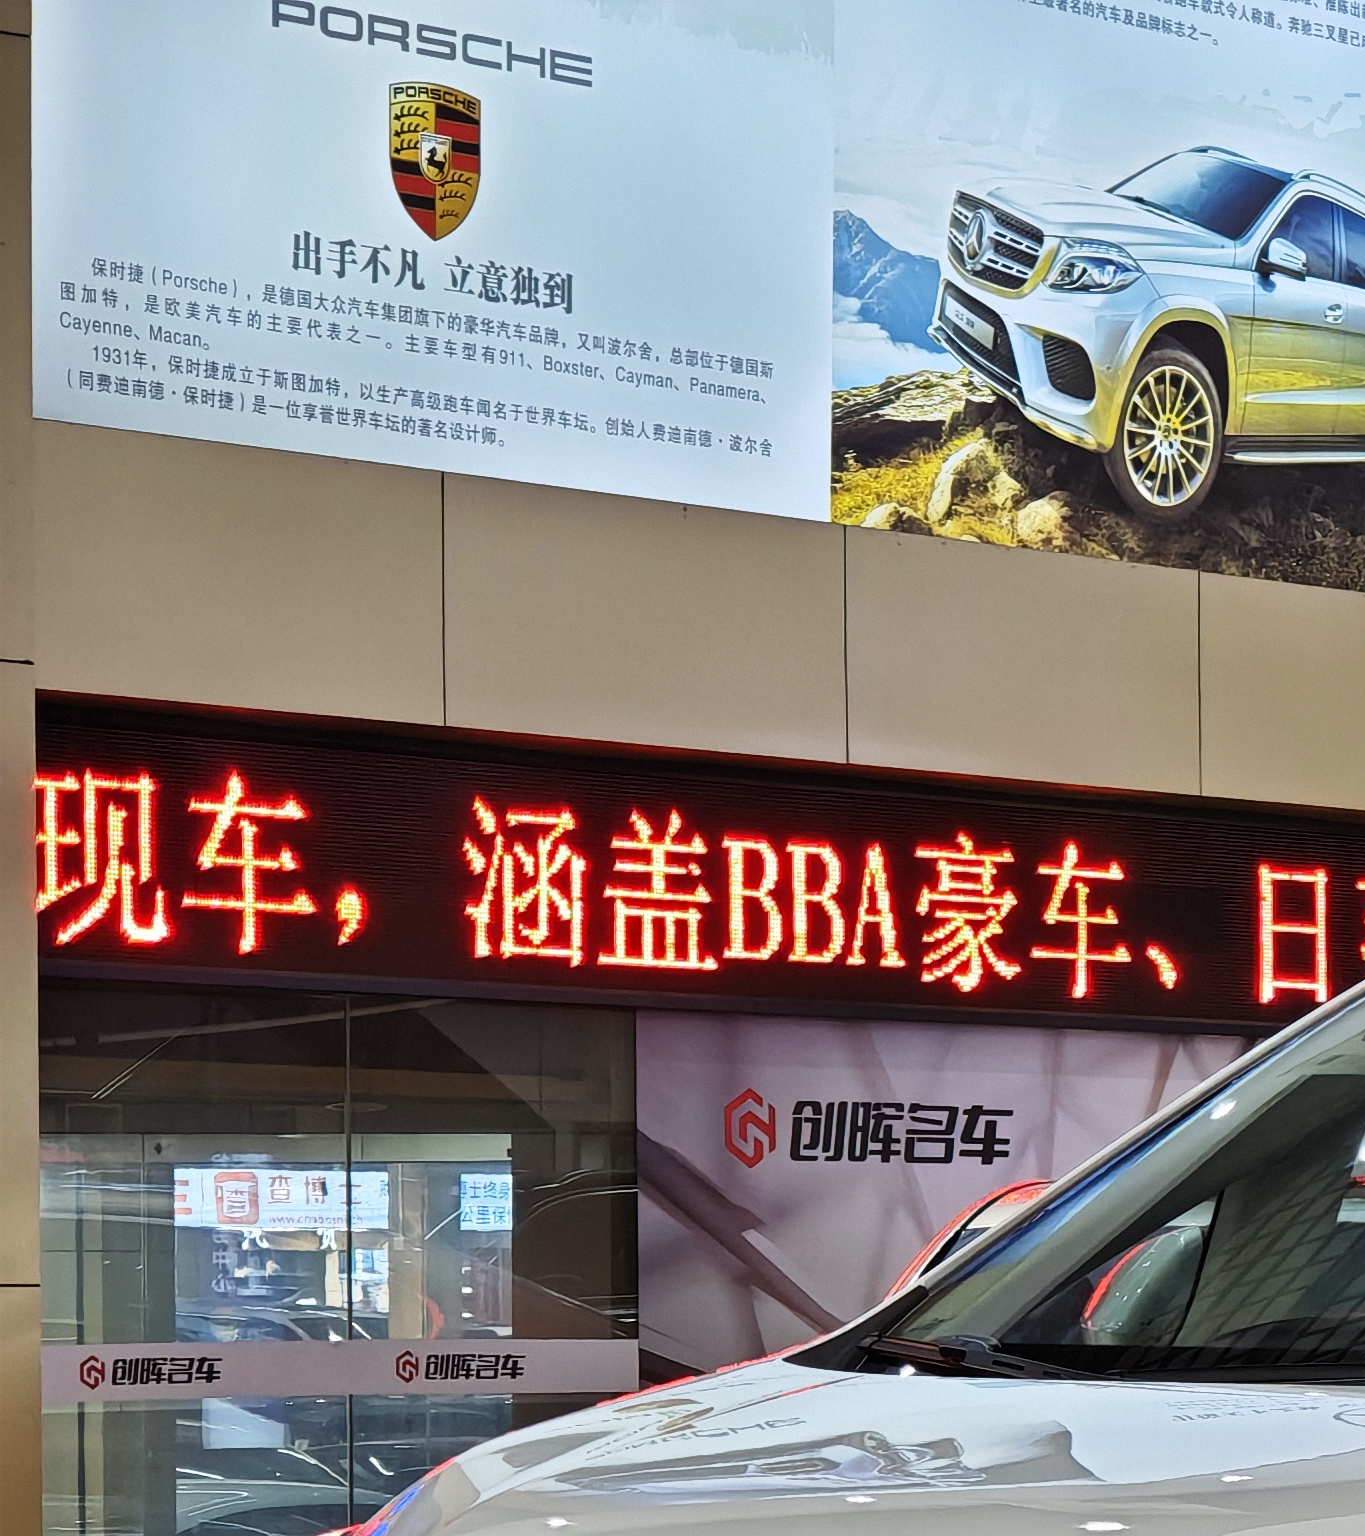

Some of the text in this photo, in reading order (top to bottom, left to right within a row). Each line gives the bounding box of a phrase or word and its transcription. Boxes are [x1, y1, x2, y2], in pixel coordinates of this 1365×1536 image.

[272, 0, 593, 88] PORSCHE
[393, 85, 477, 115] PORSCHE
[291, 230, 573, 315] 出手不凡 立意独到
[789, 1100, 1014, 1166] 创晖名车
[111, 1356, 223, 1386] 创晖名车
[424, 1352, 526, 1382] 创晖名车
